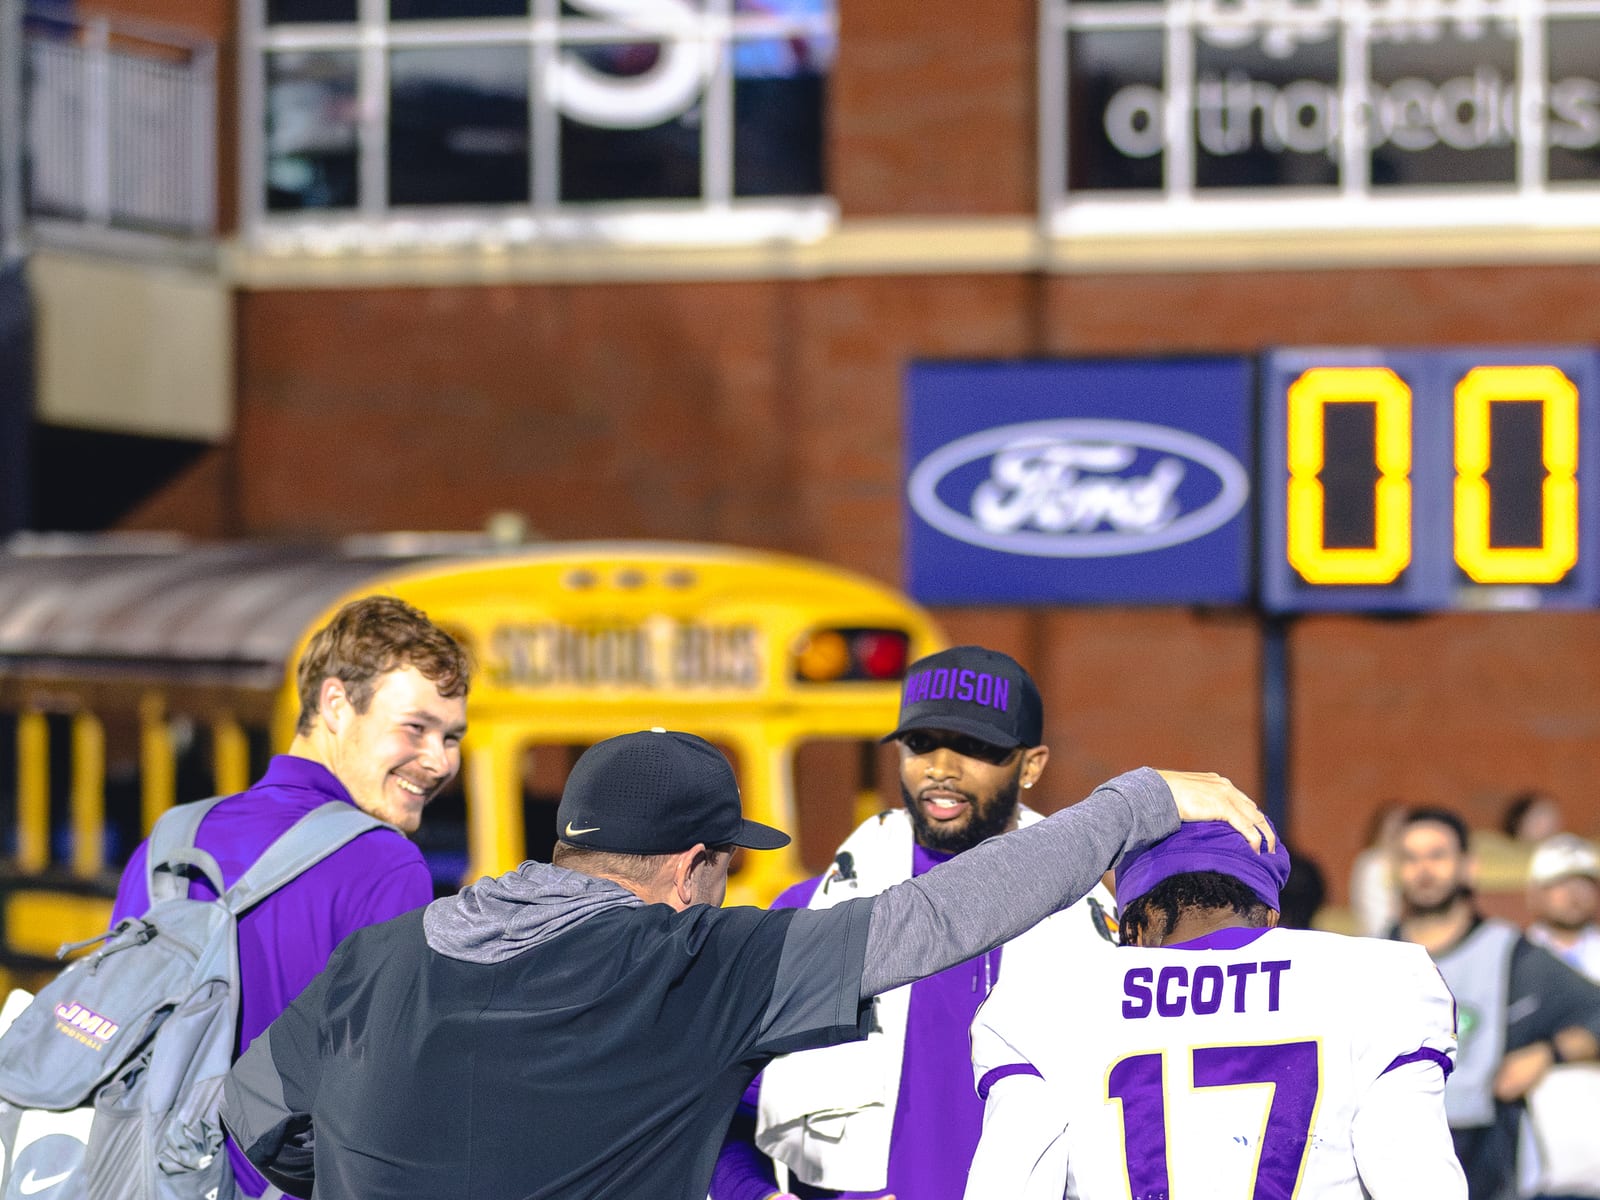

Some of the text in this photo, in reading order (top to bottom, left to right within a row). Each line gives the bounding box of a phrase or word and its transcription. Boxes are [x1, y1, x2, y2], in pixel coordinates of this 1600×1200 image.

[1104, 68, 1600, 164] othopedis
[972, 442, 1186, 533] Ford
[904, 667, 1009, 713] MADISON
[1122, 960, 1291, 1019] SCOTT
[55, 1002, 120, 1043] JMU
